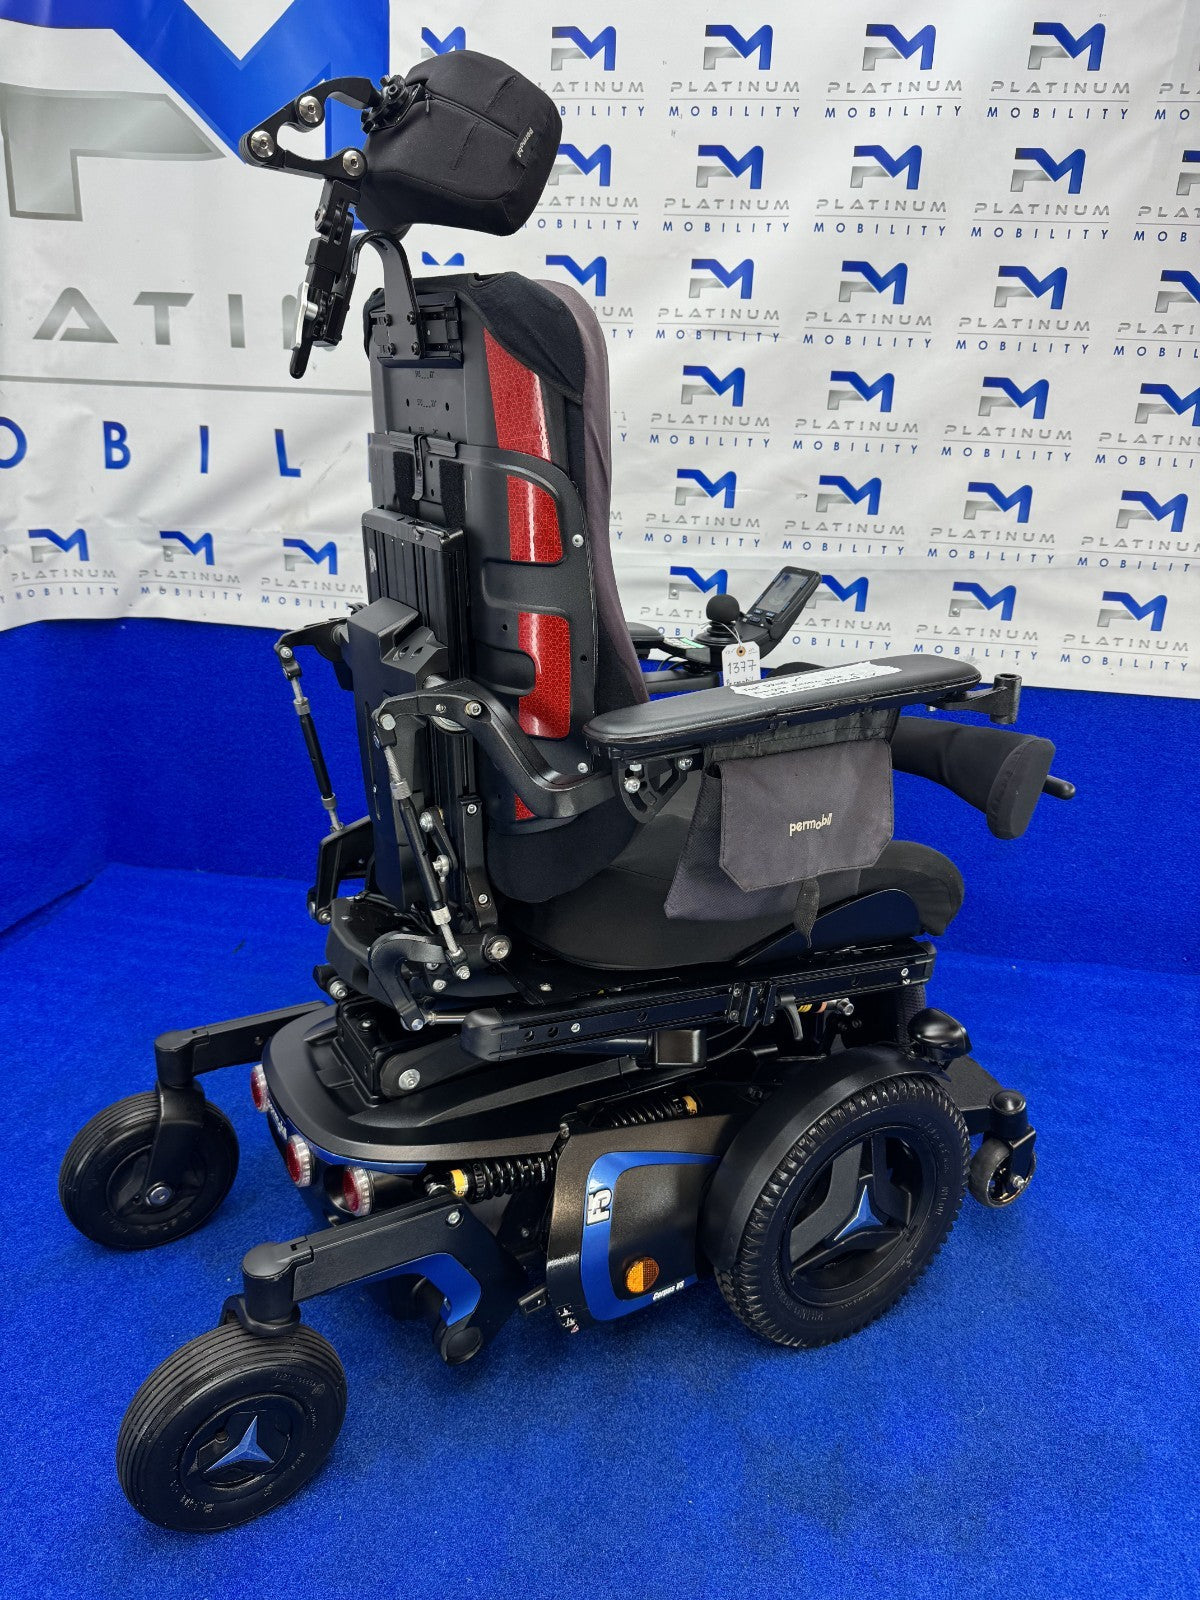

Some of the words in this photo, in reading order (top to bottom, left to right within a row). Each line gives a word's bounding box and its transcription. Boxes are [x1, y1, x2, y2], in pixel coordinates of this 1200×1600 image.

[538, 81, 645, 93] ATINUM
[669, 80, 801, 93] PLATINUM
[827, 79, 963, 94] PLATINUM
[990, 80, 1131, 94] PLATINUM
[560, 105, 645, 117] BILITY
[669, 106, 801, 118] MOBILITY
[824, 105, 963, 119] MOBILITY
[986, 107, 1129, 120] MOBILITY
[537, 196, 639, 208] ATINUM
[664, 197, 790, 211] PLATINUM
[816, 198, 947, 213] PLATINUM
[974, 202, 1110, 216] PLATINUM
[662, 220, 790, 233] MOBILITY
[813, 222, 946, 236] MOBILITY
[970, 227, 1109, 241] MOBILITY
[658, 308, 780, 321] PLATINUM
[805, 311, 932, 326] PLATINUM
[958, 317, 1091, 332] PLATINUM
[655, 329, 780, 343] MOBILITY
[803, 333, 932, 349] MOBILITY
[955, 339, 1090, 355] MOBILITY
[650, 412, 771, 428] PLATINUM
[795, 418, 919, 434] PLATINUM
[649, 433, 771, 448] MOBILITY
[944, 424, 1073, 442] PLATINUM
[793, 439, 918, 455] MOBILITY
[941, 445, 1072, 463] MOBILITY
[645, 513, 761, 529] PLATINUM
[784, 520, 905, 536] PLATINUM
[644, 532, 760, 549] MOBILITY
[930, 527, 1056, 545] PLATINUM
[782, 540, 904, 557] MOBILITY
[927, 547, 1055, 565] MOBILITY
[138, 569, 241, 584] PLATINUM
[261, 577, 363, 594] PLATINUM
[640, 606, 702, 619] PLATI
[794, 617, 892, 632] ATINUM
[916, 624, 1039, 641] PLATINUM
[792, 635, 892, 651] OBILITY
[1063, 633, 1189, 652] PLATINUM
[913, 644, 1038, 662] MOBILITY
[1060, 653, 1189, 672] MOBILITY
[789, 812, 833, 837] permobil
